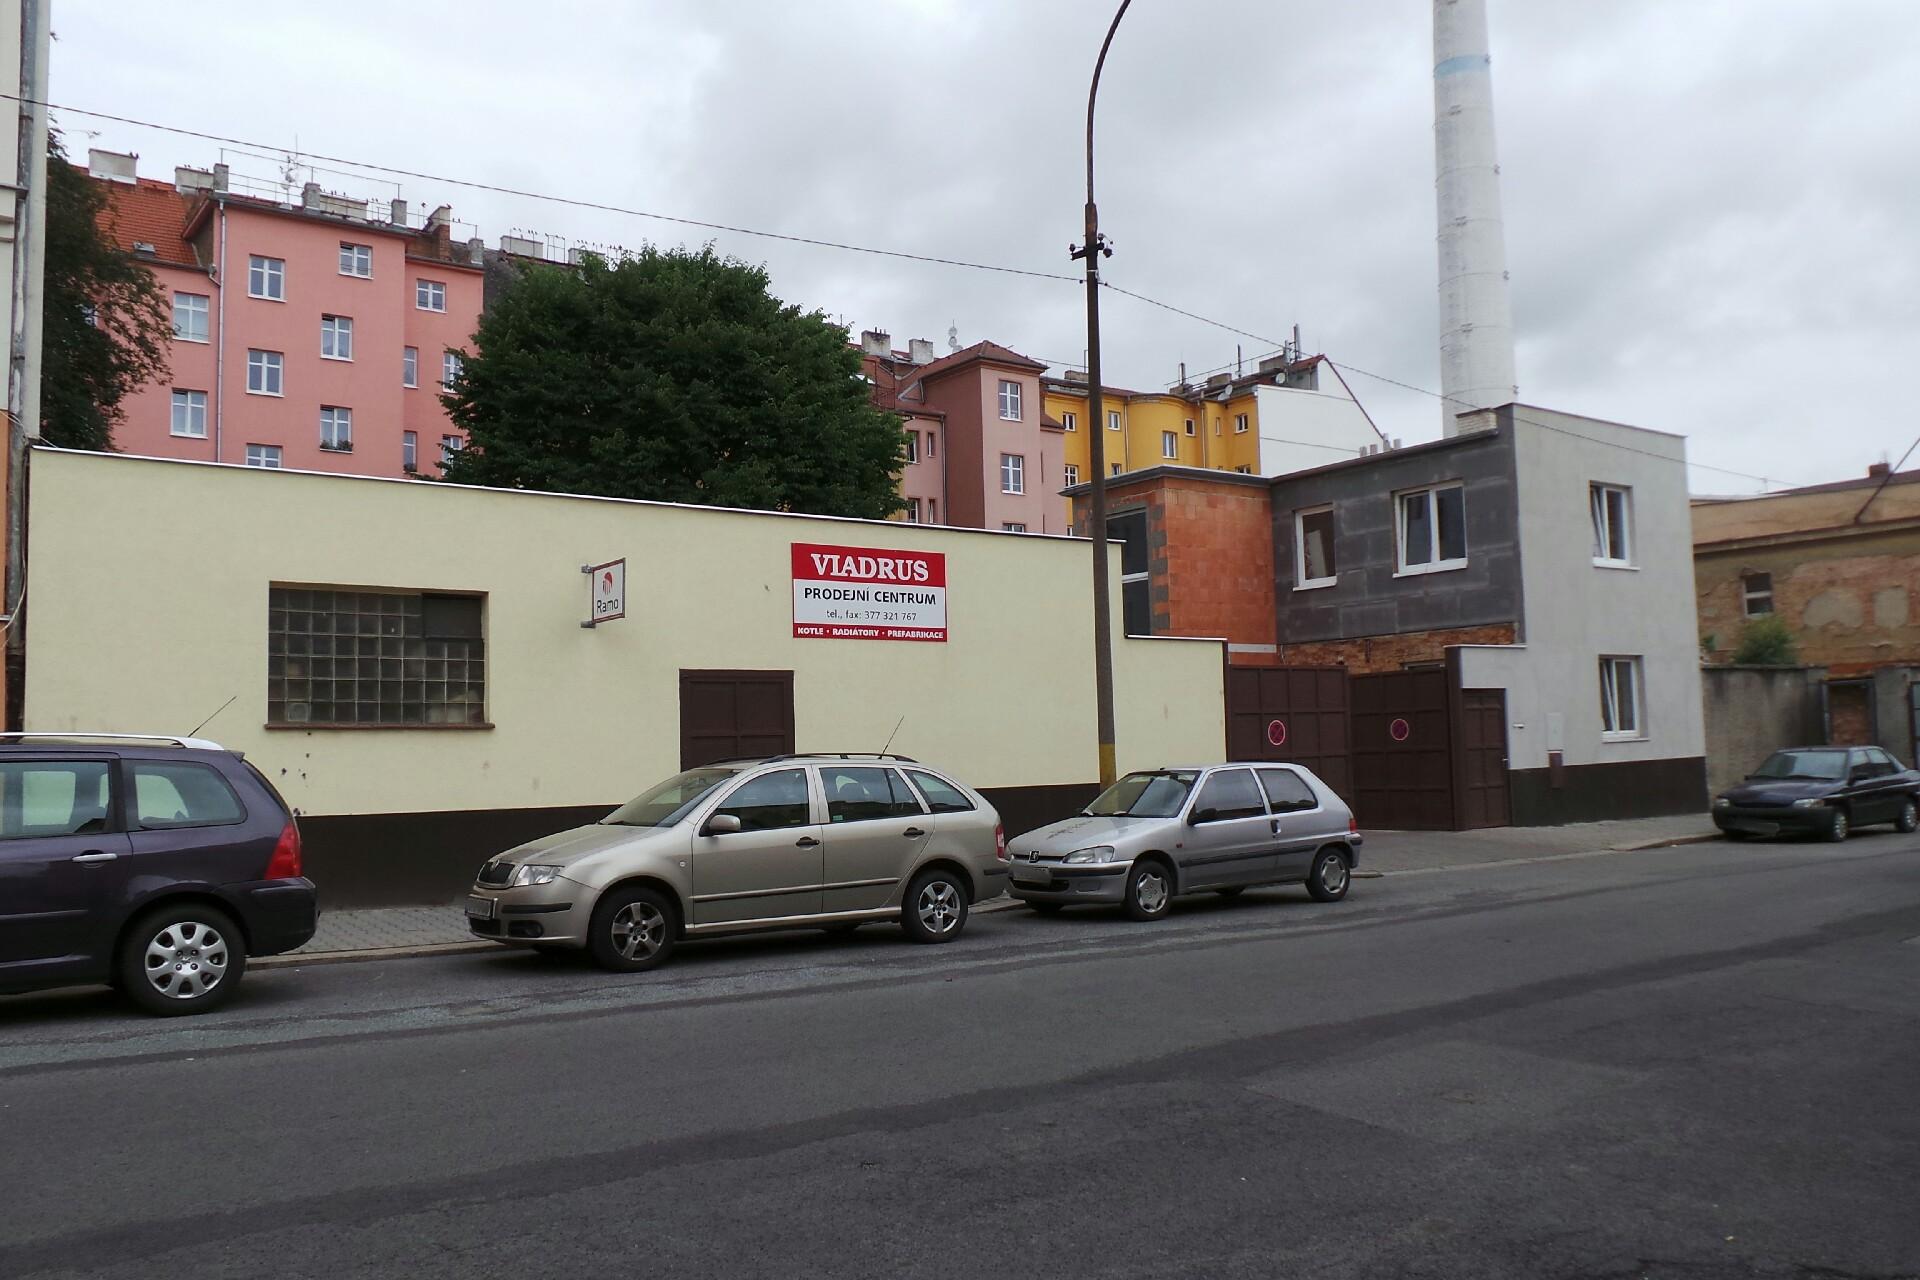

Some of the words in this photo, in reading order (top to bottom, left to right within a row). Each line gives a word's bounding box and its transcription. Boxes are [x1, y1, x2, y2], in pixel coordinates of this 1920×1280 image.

[811, 553, 929, 581] VIADRUS
[804, 587, 869, 602] PRODEJNÍ
[874, 591, 936, 605] CENTRUM
[597, 599, 619, 614] Ramo
[826, 609, 843, 619] tel.,
[845, 610, 862, 619] fax:
[864, 611, 880, 620] 377
[883, 611, 898, 621] 321
[901, 612, 917, 621] 767
[797, 627, 823, 635] KOTLE
[832, 627, 879, 637] RADIÁTORY
[887, 629, 944, 639] PREFABRIKACE
